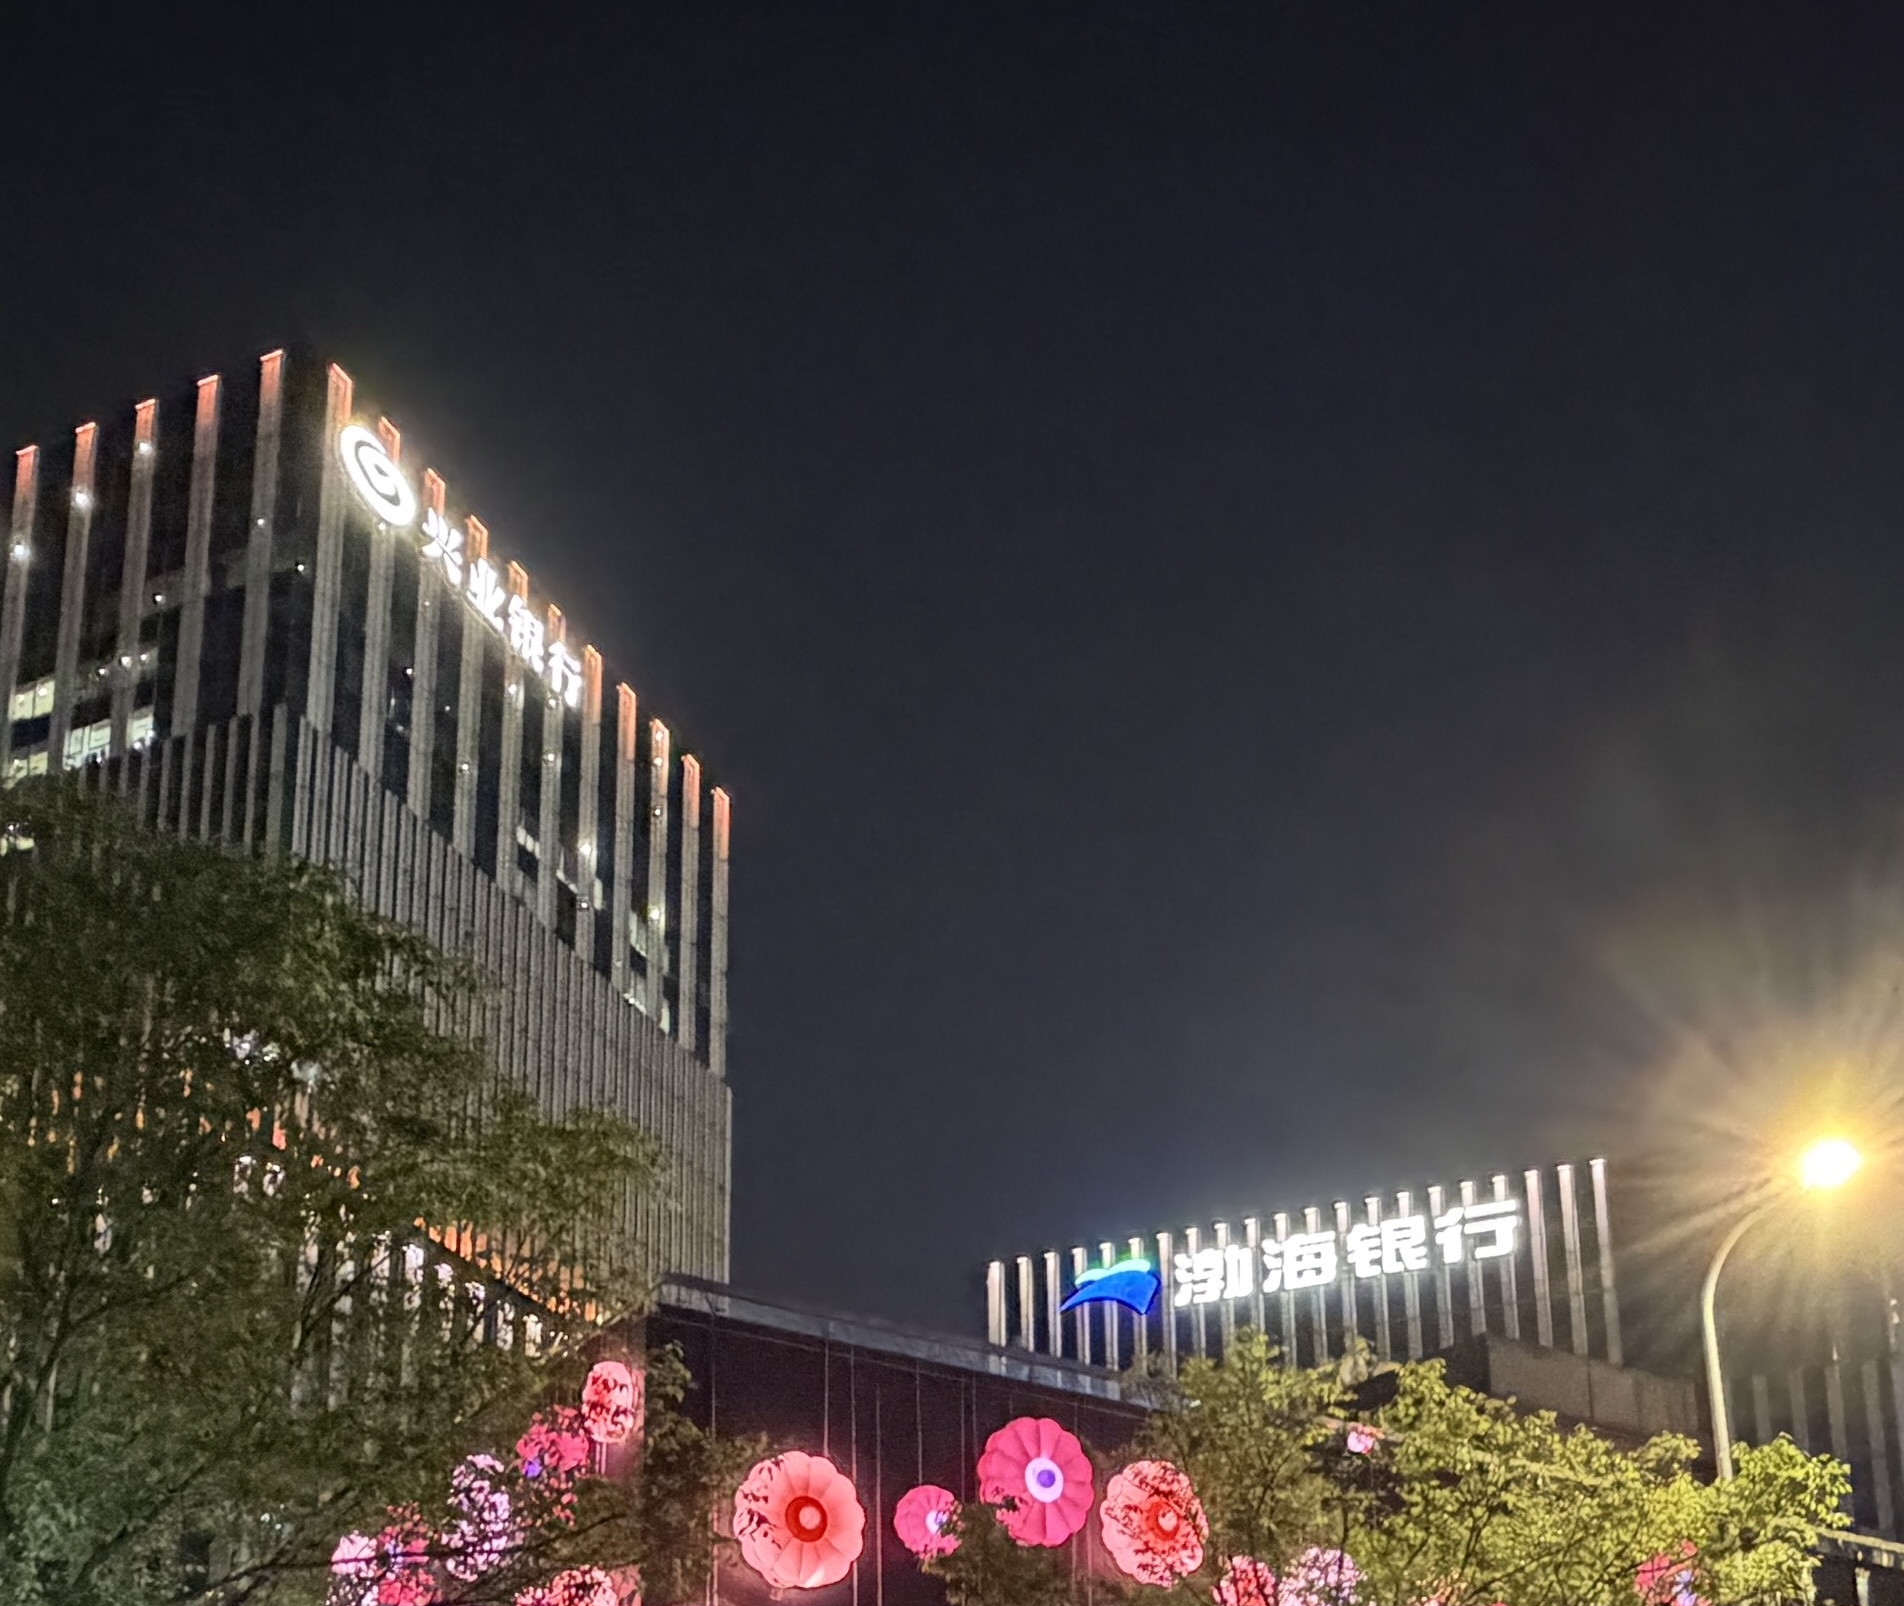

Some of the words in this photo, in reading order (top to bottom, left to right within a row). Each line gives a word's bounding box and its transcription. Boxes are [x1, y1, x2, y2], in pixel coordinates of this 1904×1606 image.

[421, 507, 583, 709] 兴业银行
[1175, 1200, 1518, 1307] 渤海银行
